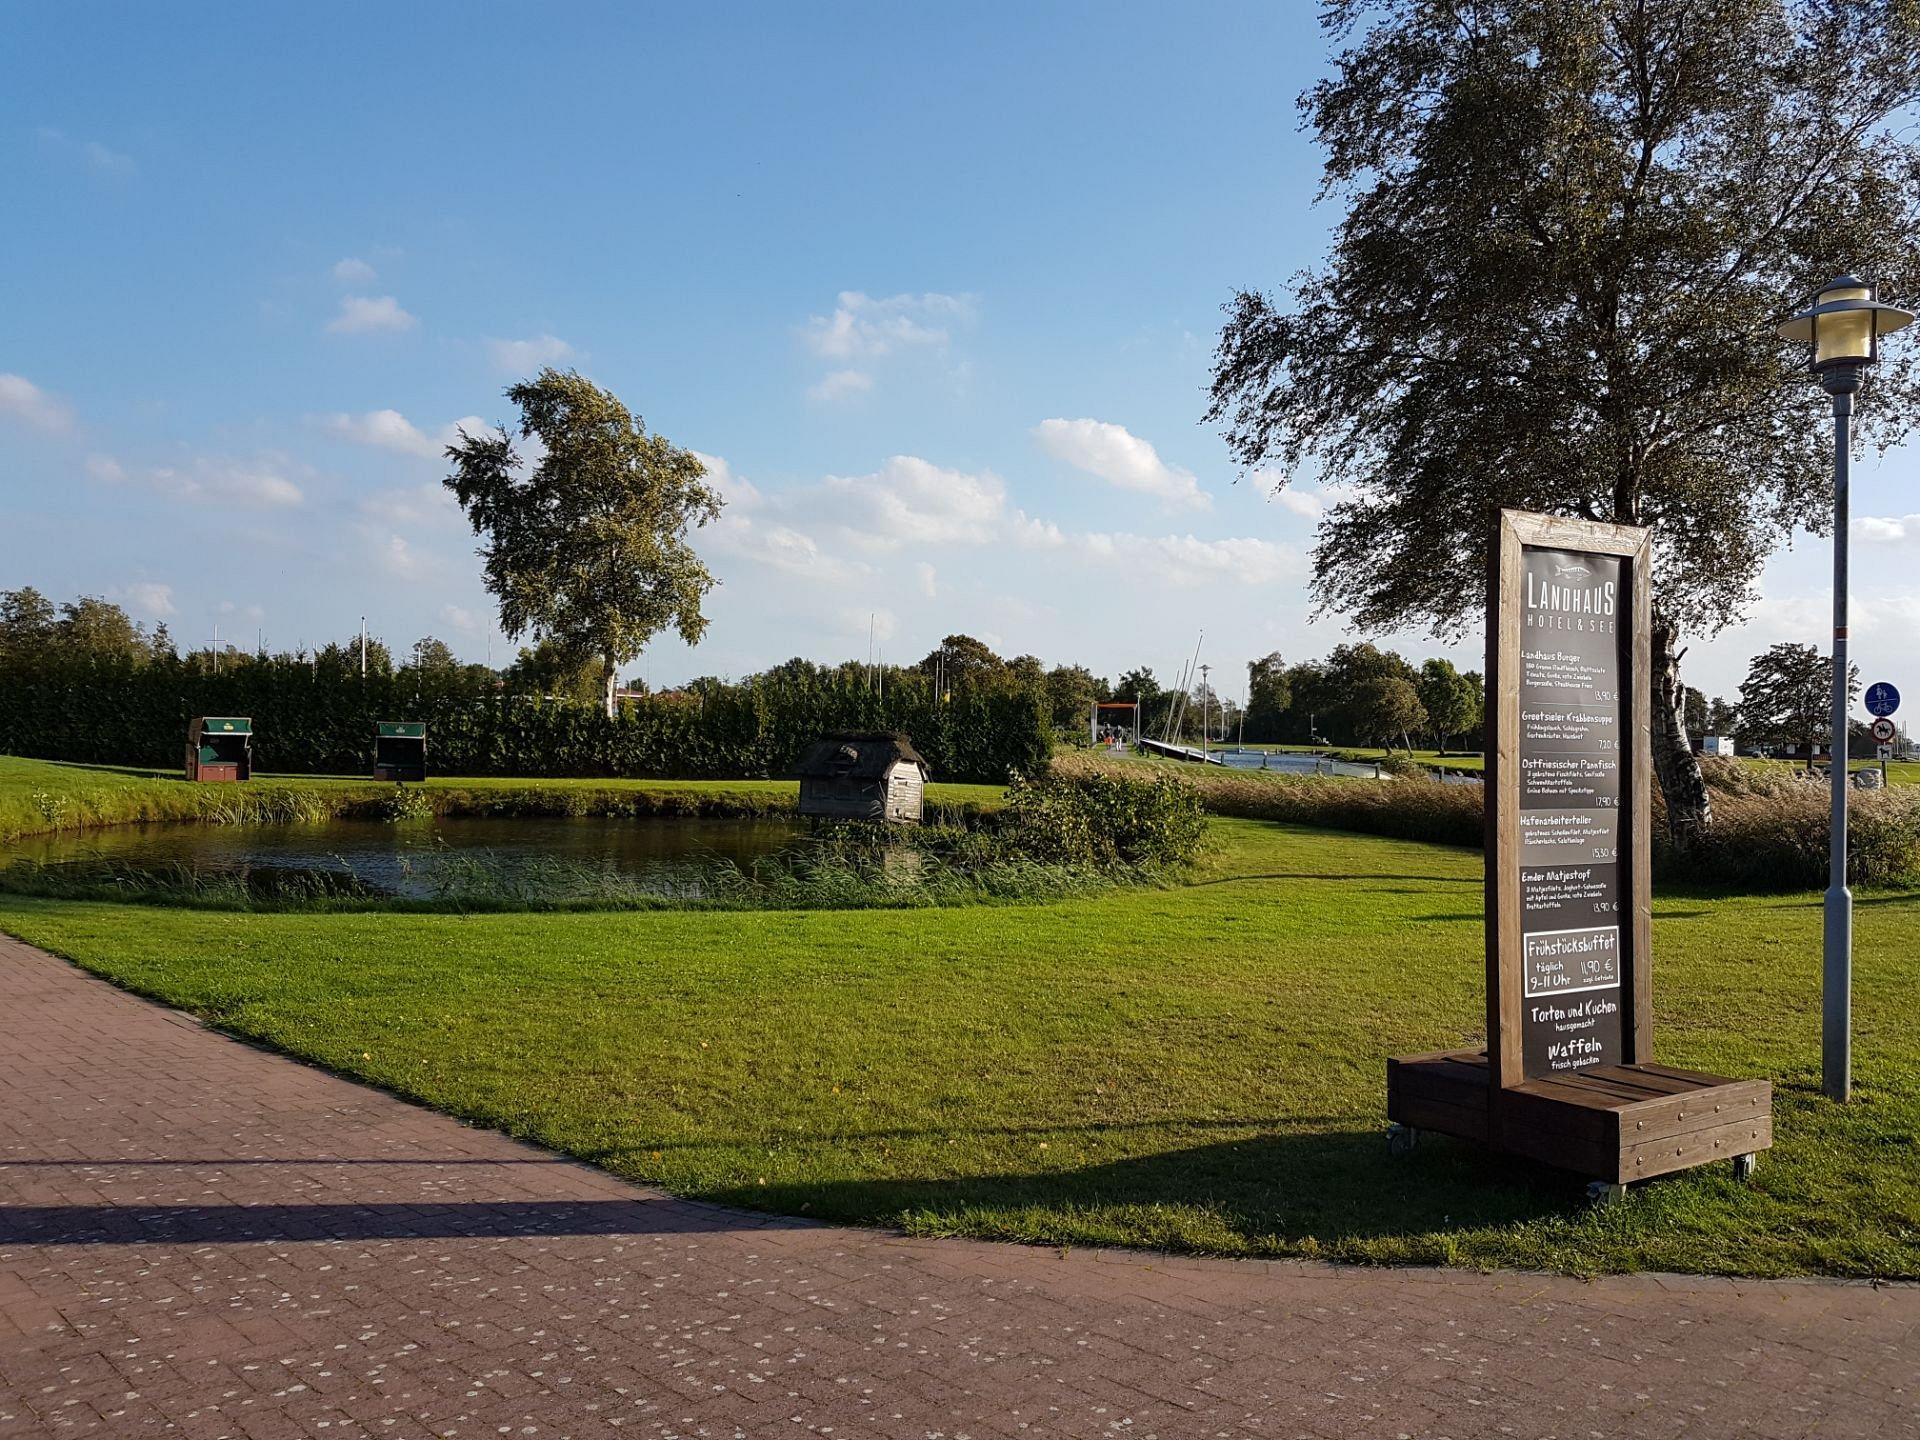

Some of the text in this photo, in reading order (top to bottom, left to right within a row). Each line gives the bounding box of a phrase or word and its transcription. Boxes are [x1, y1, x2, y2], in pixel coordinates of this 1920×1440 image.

[1528, 572, 1614, 616] LANDHAUS
[1528, 614, 1614, 634] HOTEL & SEE
[1521, 650, 1580, 664] Landhaus Burger
[1594, 691, 1619, 702] 13,90 €
[1566, 712, 1612, 726] Krabbensuppe
[1614, 740, 1620, 750] €
[1522, 758, 1616, 770] Ostfriesischer Pannfisch
[1596, 796, 1620, 807] 17,90 €
[1520, 815, 1592, 826] Hafenarbeiterteller
[1592, 848, 1618, 858] 15,30 €
[1522, 869, 1592, 882] Emder Matjestopf
[1612, 902, 1620, 911] €
[1528, 934, 1615, 956] Frühstücksbuffet
[1536, 960, 1564, 974] täglich
[1580, 958, 1614, 975] 11,90 €
[1530, 974, 1571, 990] 9-11 Uhr
[1531, 998, 1617, 1022] Torten und Kuchen
[1556, 1018, 1596, 1032] hausgemacht
[1548, 1037, 1602, 1060] Waffeln
[1551, 1056, 1600, 1070] frisch gebacken
